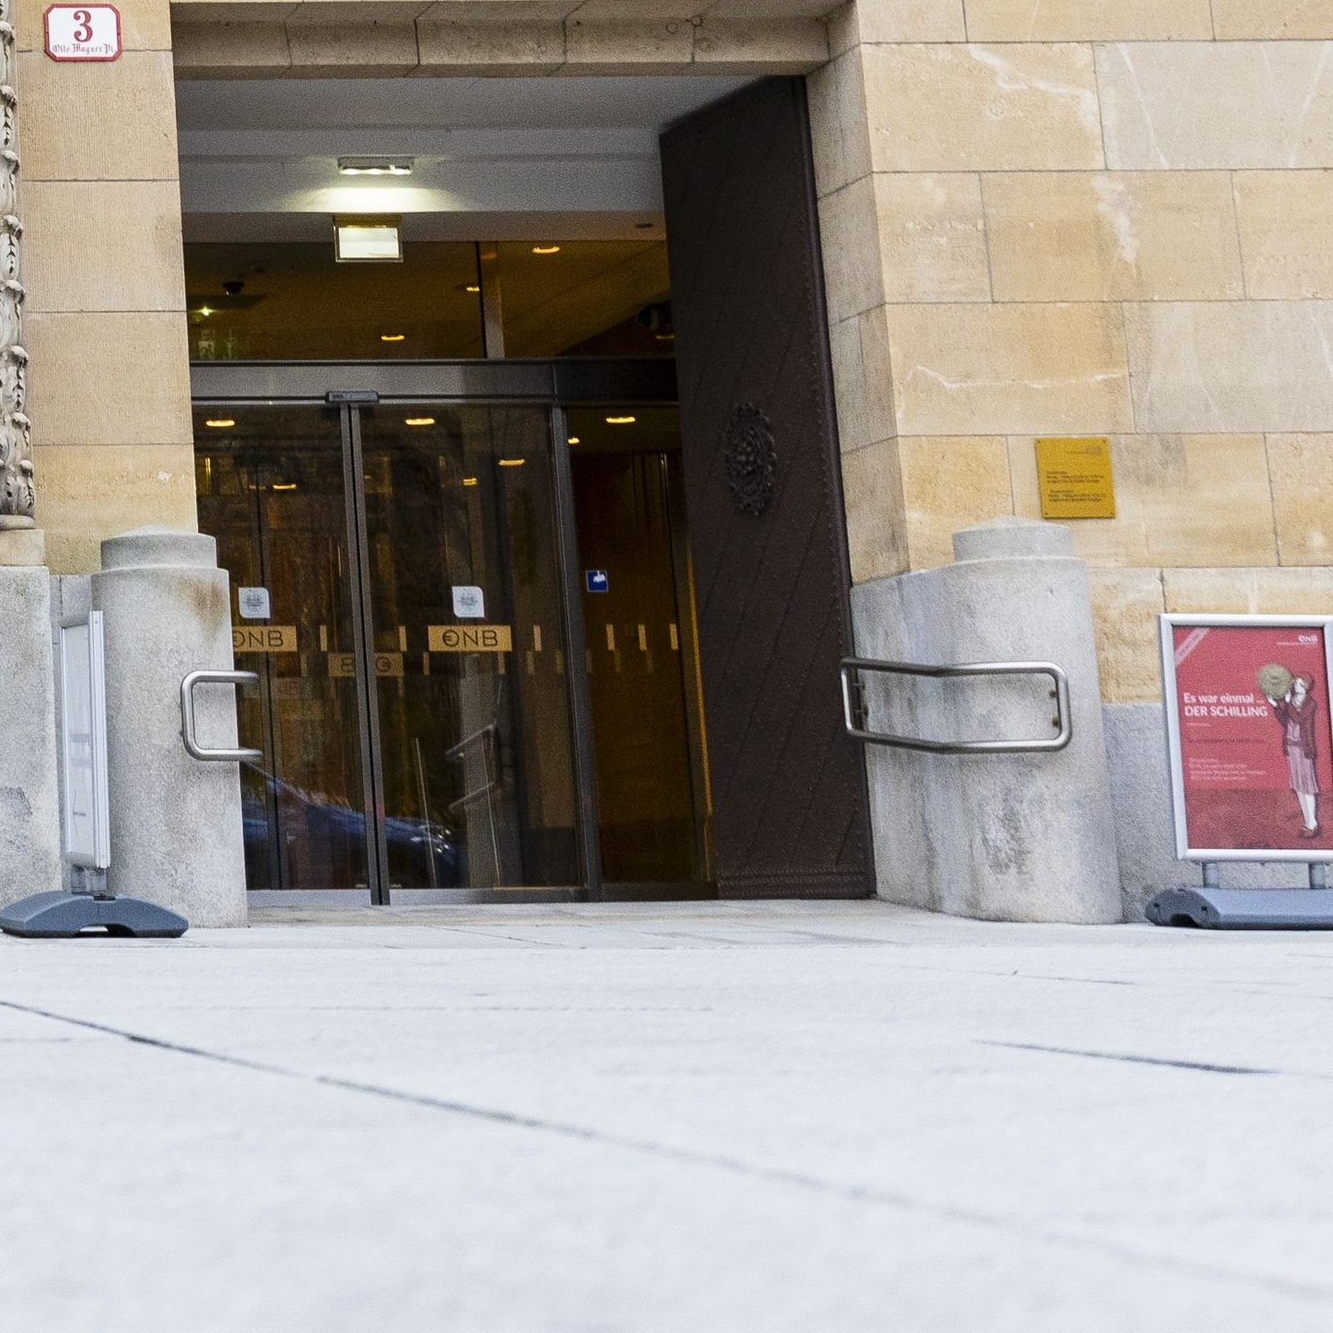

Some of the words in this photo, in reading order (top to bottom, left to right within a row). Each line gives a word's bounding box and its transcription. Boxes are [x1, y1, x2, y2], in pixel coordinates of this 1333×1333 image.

[73, 10, 94, 42] 3
[1183, 693, 1197, 704] Es
[1198, 694, 1218, 704] war
[1220, 692, 1254, 704] einmal
[1185, 706, 1208, 717] DER
[1211, 705, 1269, 718] SCHILLING
